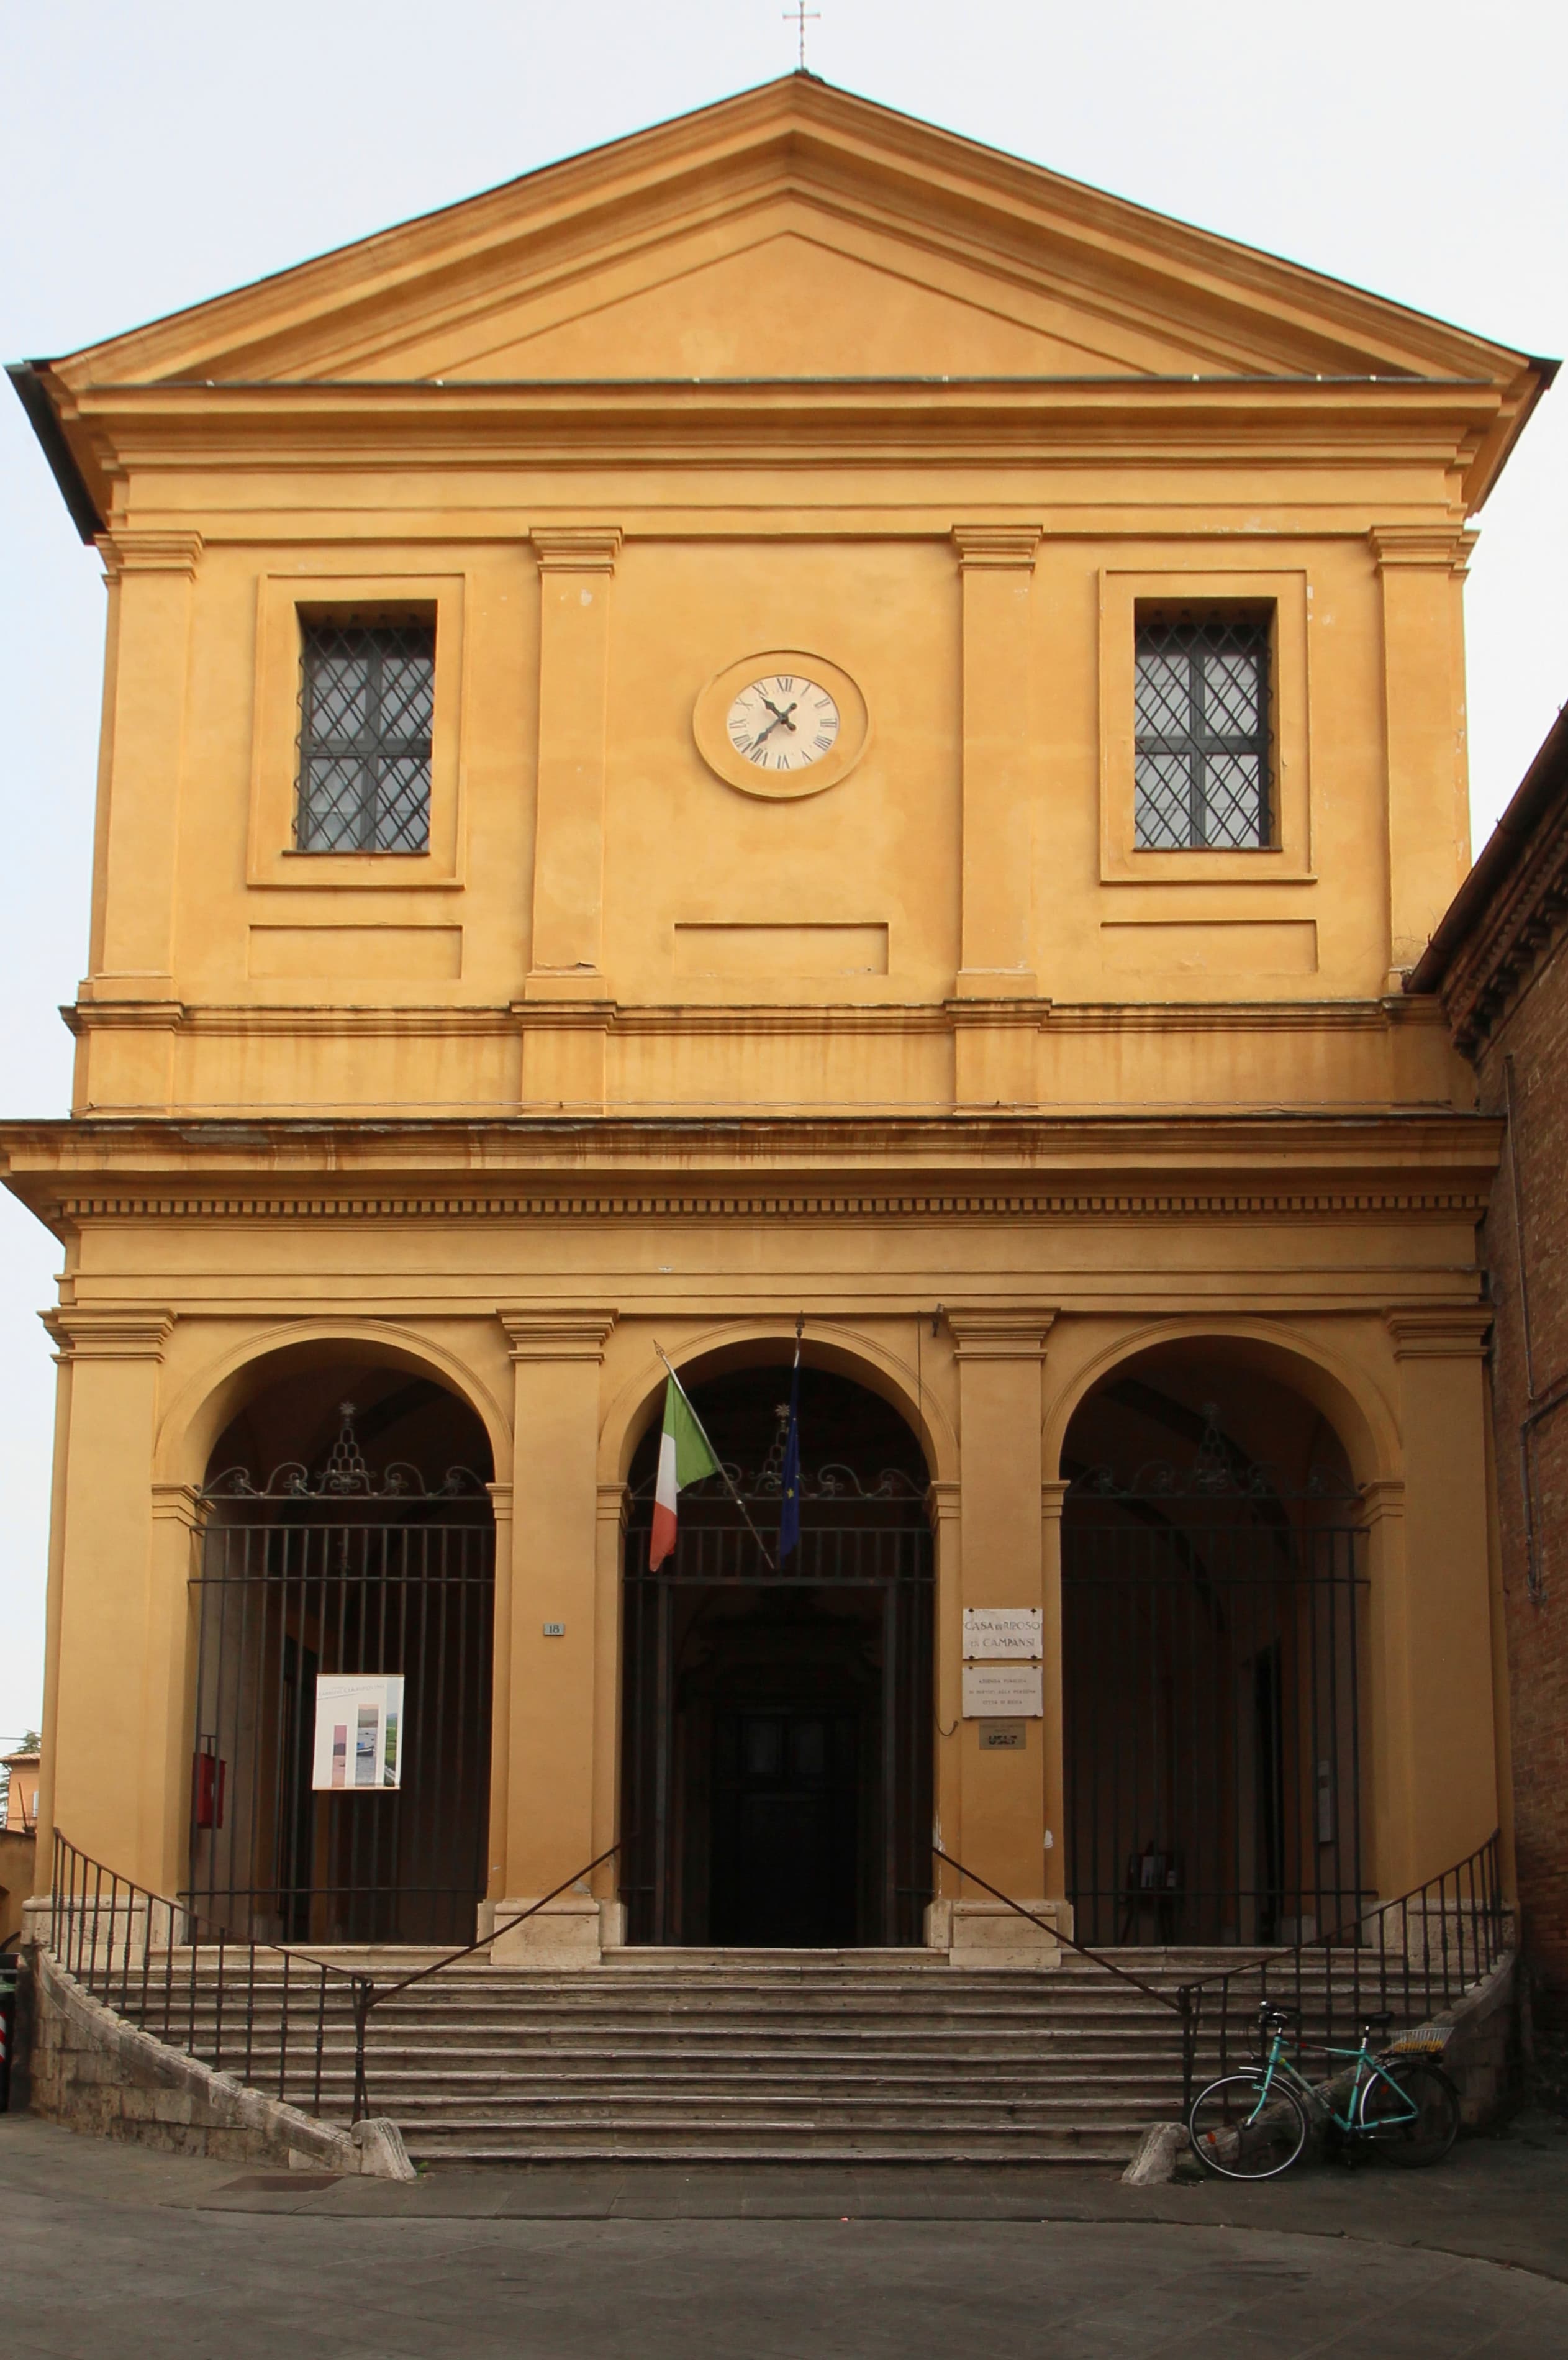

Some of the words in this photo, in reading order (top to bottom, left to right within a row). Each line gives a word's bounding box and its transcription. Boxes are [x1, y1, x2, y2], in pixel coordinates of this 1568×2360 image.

[550, 1625, 560, 1633] 18
[964, 1621, 994, 1630] CASA
[1004, 1621, 1040, 1630] RIPOSO
[982, 1638, 1035, 1647] CAMPANSI
